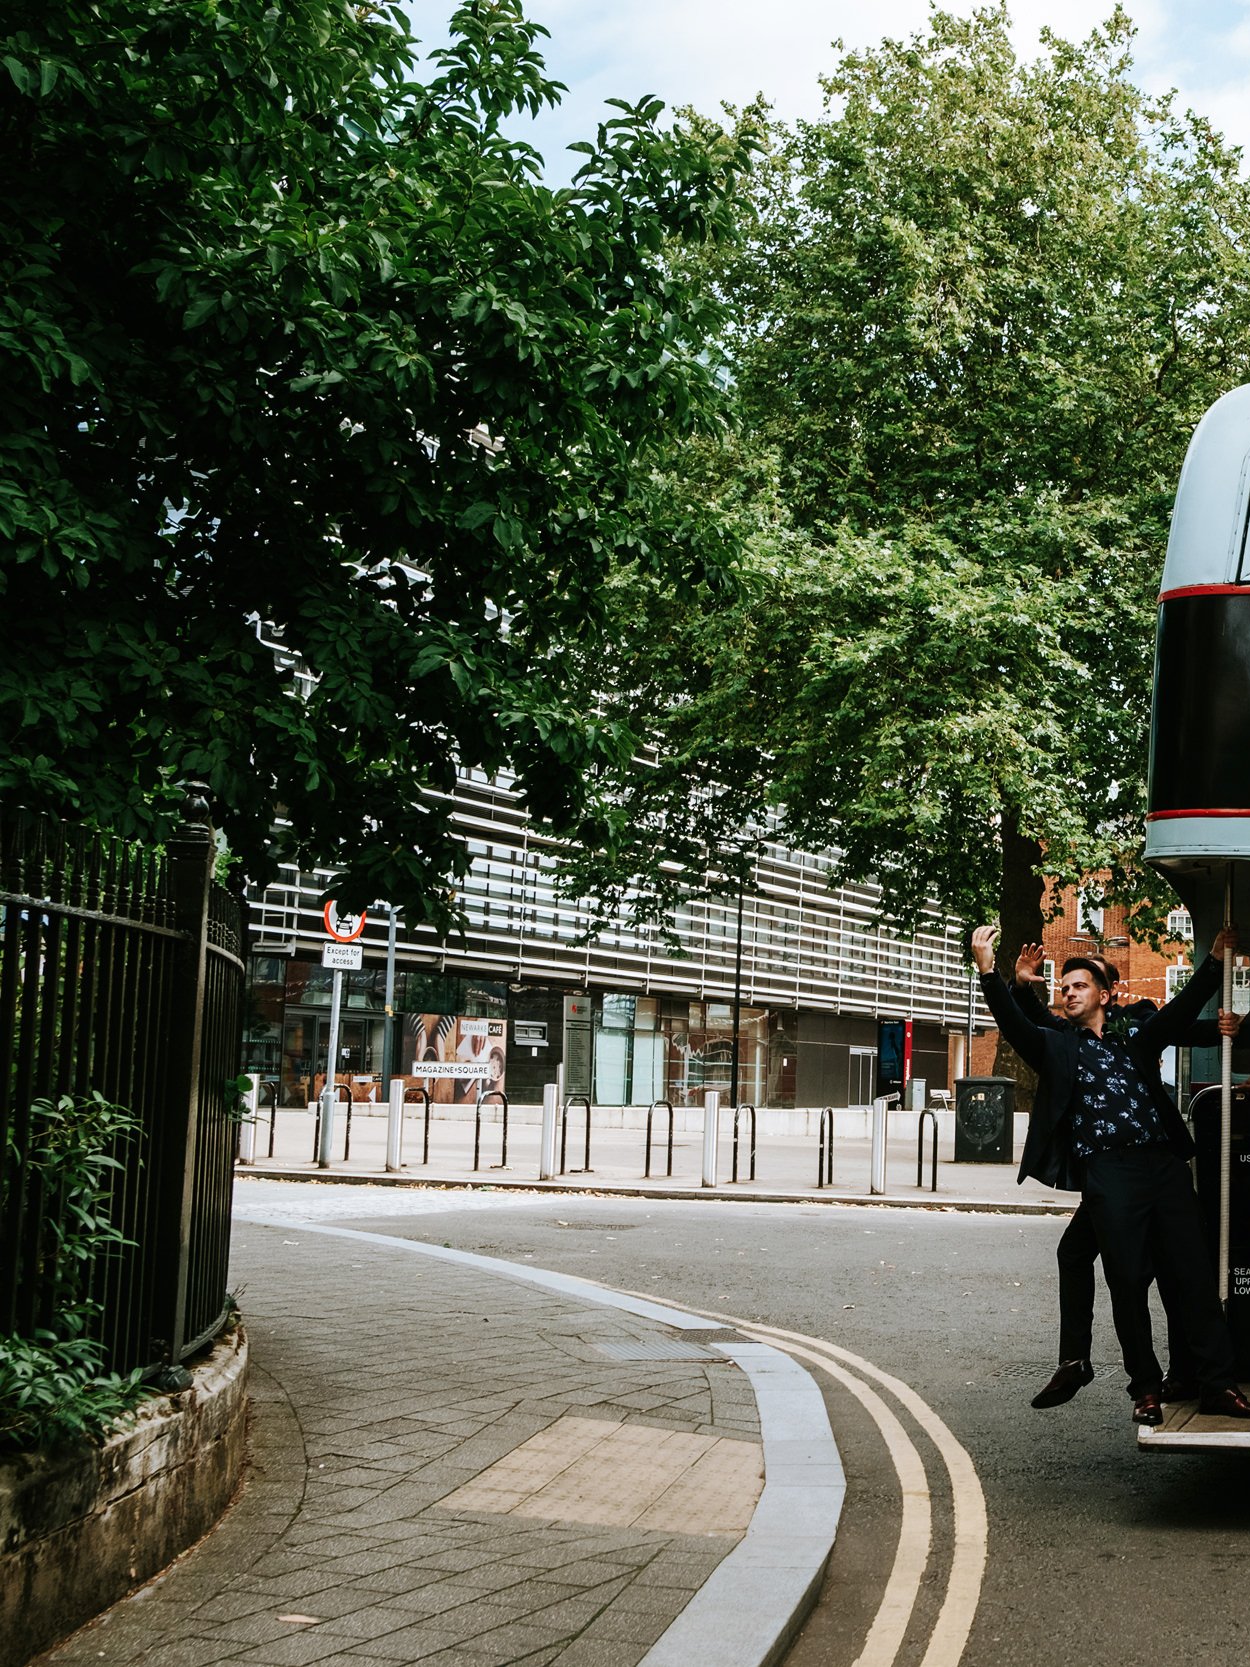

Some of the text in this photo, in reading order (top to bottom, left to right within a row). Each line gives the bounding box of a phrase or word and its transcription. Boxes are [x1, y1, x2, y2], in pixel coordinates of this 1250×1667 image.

[326, 946, 360, 957] Except for
[331, 957, 354, 966] access
[415, 1065, 488, 1075] MAGAZINE SQUARE
